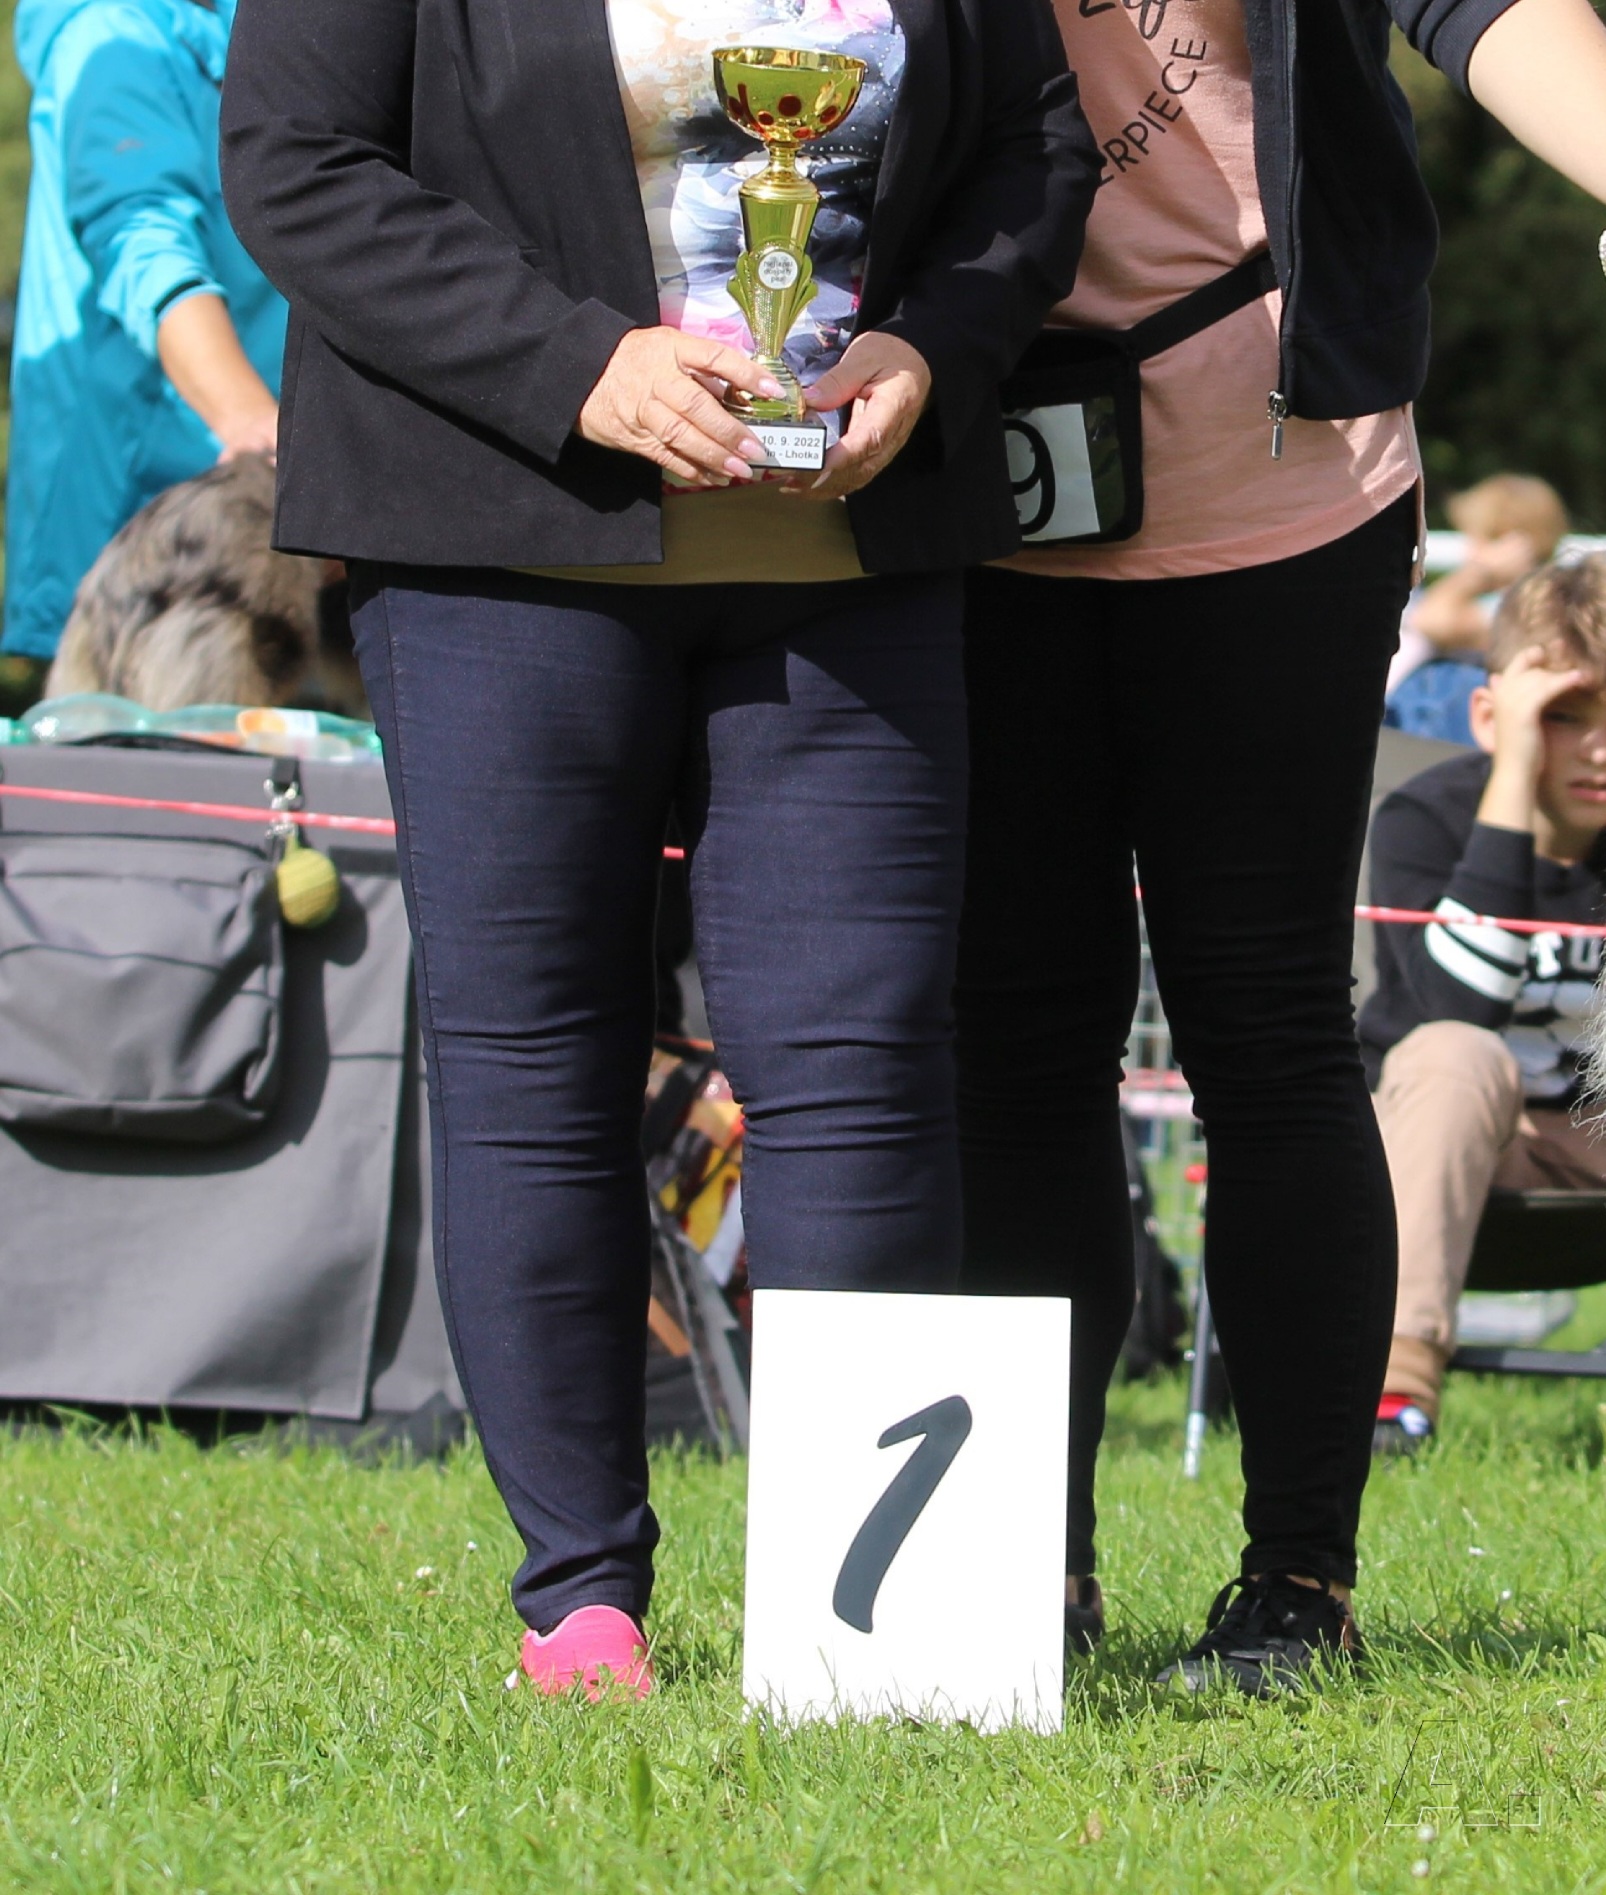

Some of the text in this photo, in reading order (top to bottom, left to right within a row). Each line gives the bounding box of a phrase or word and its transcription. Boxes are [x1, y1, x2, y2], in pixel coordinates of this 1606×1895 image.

[780, 436, 790, 446] 9.
[794, 437, 821, 448] 2022
[785, 450, 819, 460] Lhotka
[832, 1394, 973, 1634] 1
